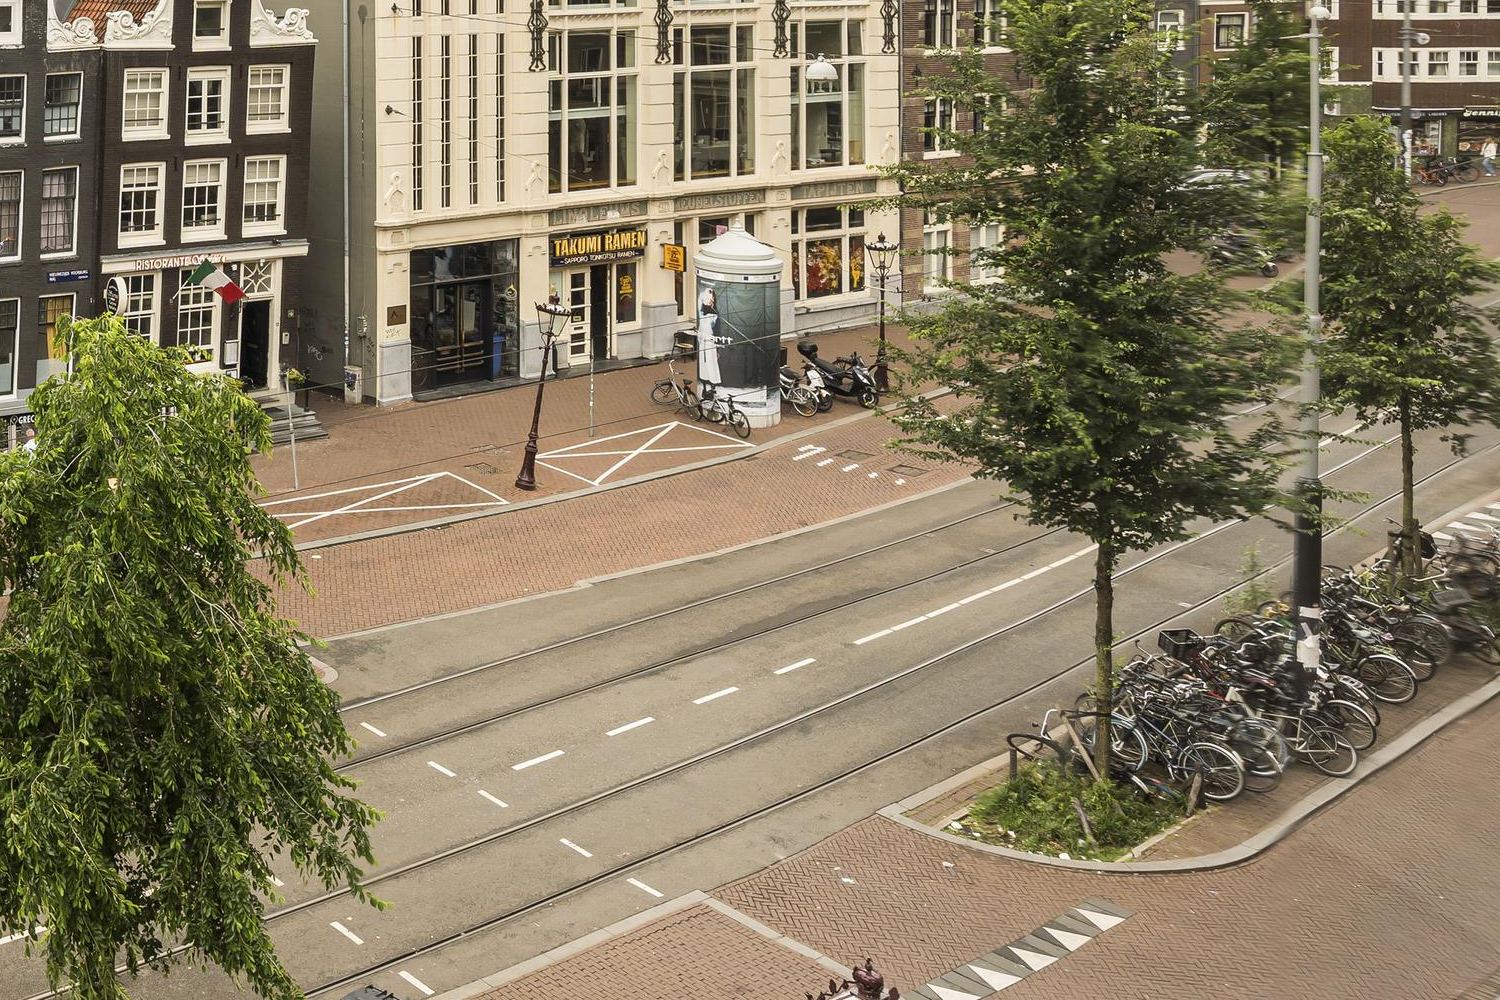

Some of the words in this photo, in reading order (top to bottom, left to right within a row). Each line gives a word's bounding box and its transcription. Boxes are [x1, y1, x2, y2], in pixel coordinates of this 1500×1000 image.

[554, 235, 601, 258] TAKUMI
[604, 231, 645, 252] RAMEN
[135, 256, 191, 271] RISTORANTE
